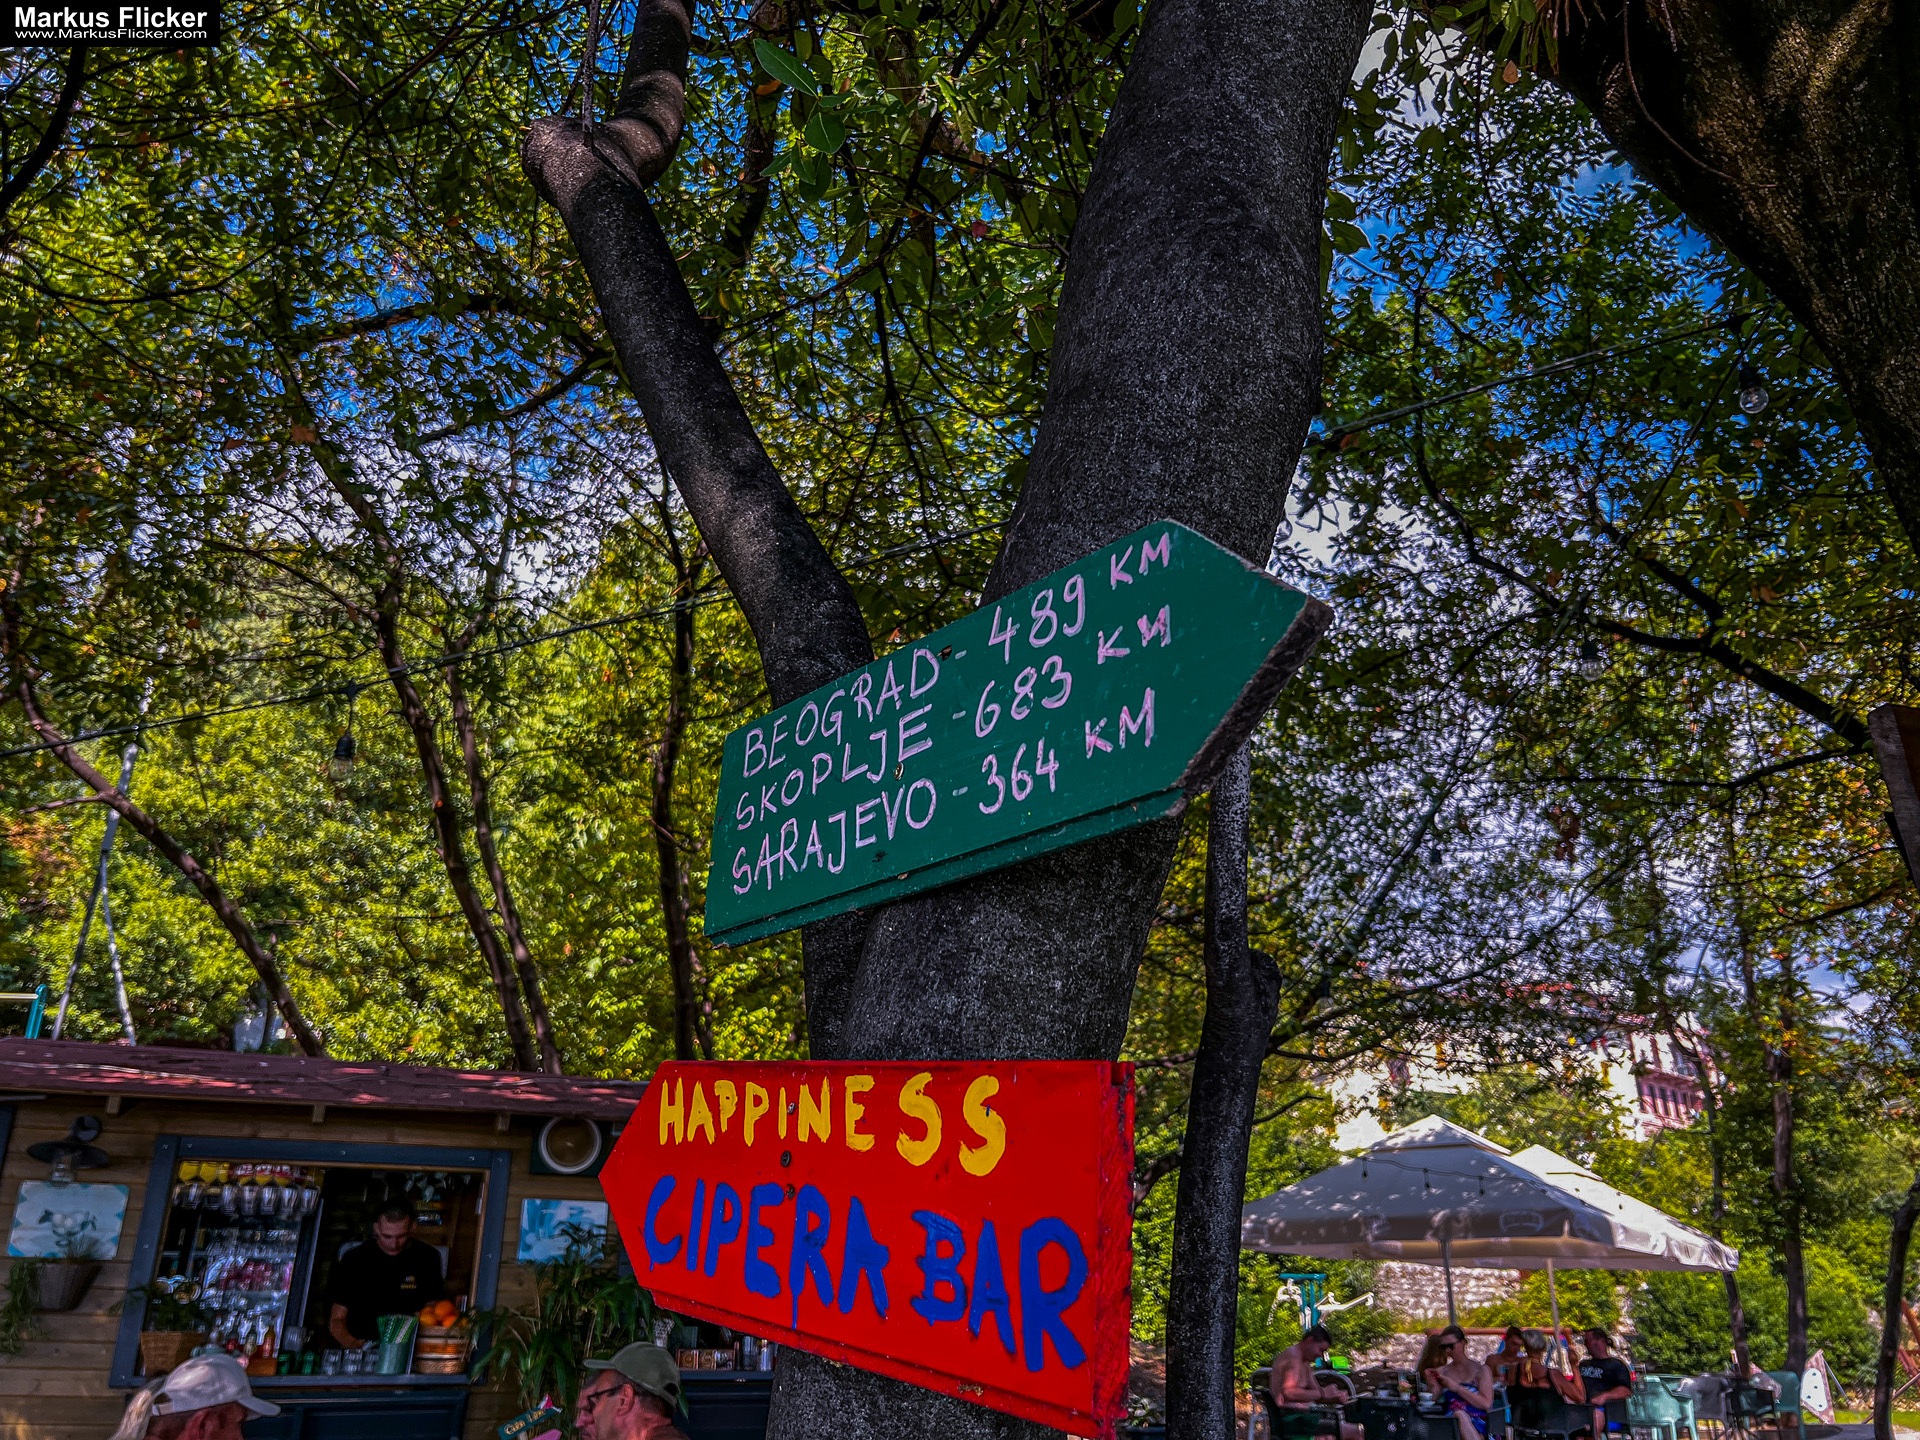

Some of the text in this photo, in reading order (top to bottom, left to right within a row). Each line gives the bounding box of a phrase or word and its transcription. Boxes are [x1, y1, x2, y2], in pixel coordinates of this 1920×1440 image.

[736, 703, 933, 831] SKOPLJE
[1096, 603, 1172, 665] KM
[742, 648, 940, 778] BEOGRAD
[988, 573, 1086, 665] 489
[1109, 531, 1171, 591] KM
[733, 778, 937, 895] SARAJEVO
[1084, 686, 1156, 760] KM
[658, 1071, 1007, 1177] HAPPINESS
[643, 1174, 1089, 1372] CIPERA BAR
